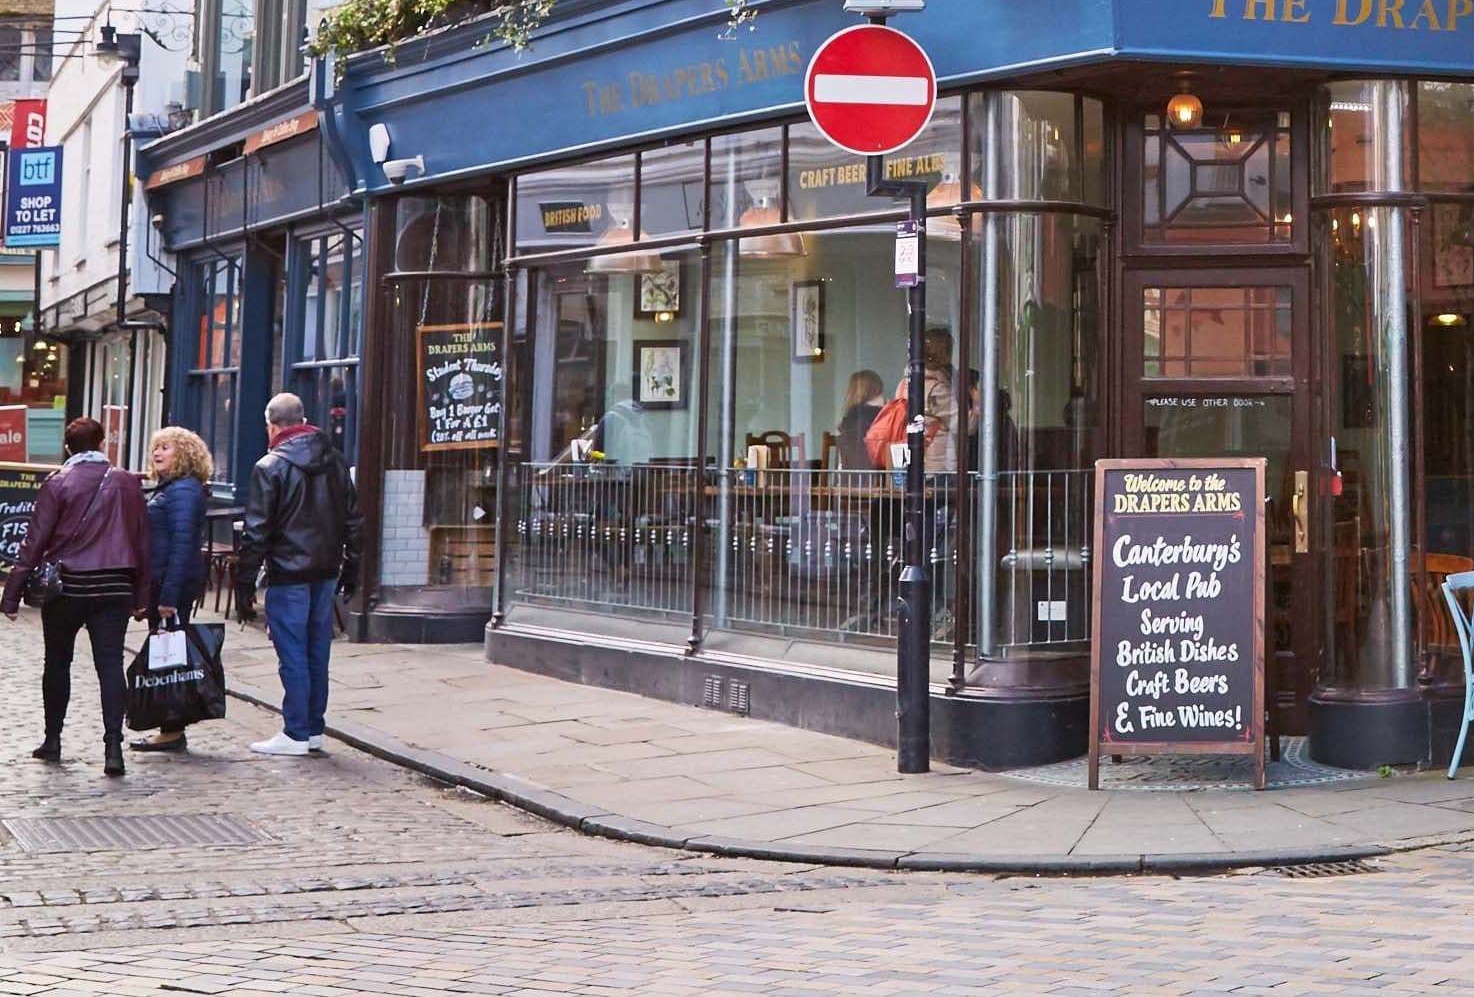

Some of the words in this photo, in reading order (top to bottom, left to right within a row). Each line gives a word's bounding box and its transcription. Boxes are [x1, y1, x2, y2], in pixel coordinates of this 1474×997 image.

[583, 80, 625, 118] THE
[629, 57, 729, 108] DRAPERS
[737, 40, 803, 86] ARMS
[23, 156, 52, 181] btf
[799, 166, 836, 189] CRAFT
[885, 156, 914, 180] FINE
[915, 152, 946, 175] ALES
[20, 195, 52, 210] SHOP
[15, 210, 31, 223] TO
[33, 208, 57, 222] LET
[544, 208, 577, 228] BRITISH
[577, 203, 602, 222] FOOD
[427, 343, 469, 355] DRAPERS
[470, 342, 496, 353] ARMS
[429, 406, 447, 420] Buy
[449, 404, 455, 417] 1
[484, 402, 501, 415] Get
[1151, 398, 1179, 407] PLEASE
[1181, 398, 1197, 407] USE
[1202, 398, 1229, 407] OTHER
[1233, 398, 1254, 407] DOOR
[435, 419, 441, 430] 1
[463, 417, 472, 429] A
[0, 430, 22, 444] ale
[1123, 473, 1186, 493] Welcome
[1189, 474, 1202, 492] to
[1204, 473, 1226, 491] the
[1113, 493, 1190, 513] DRAPERS
[1191, 491, 1241, 512] ARMS
[2, 522, 29, 538] FIS
[1112, 534, 1241, 572] Canterbury's
[1121, 573, 1180, 604] Local
[1185, 571, 1222, 601] Pub
[1140, 607, 1204, 640] Serving
[1116, 639, 1176, 667] British
[1178, 639, 1239, 663] Dishes
[135, 668, 205, 689] Debenhams
[1126, 669, 1171, 700] Craft
[1174, 667, 1229, 695] Beers
[1114, 702, 1135, 734] &
[1138, 705, 1176, 731] Fine
[1177, 705, 1242, 730] Wines!
